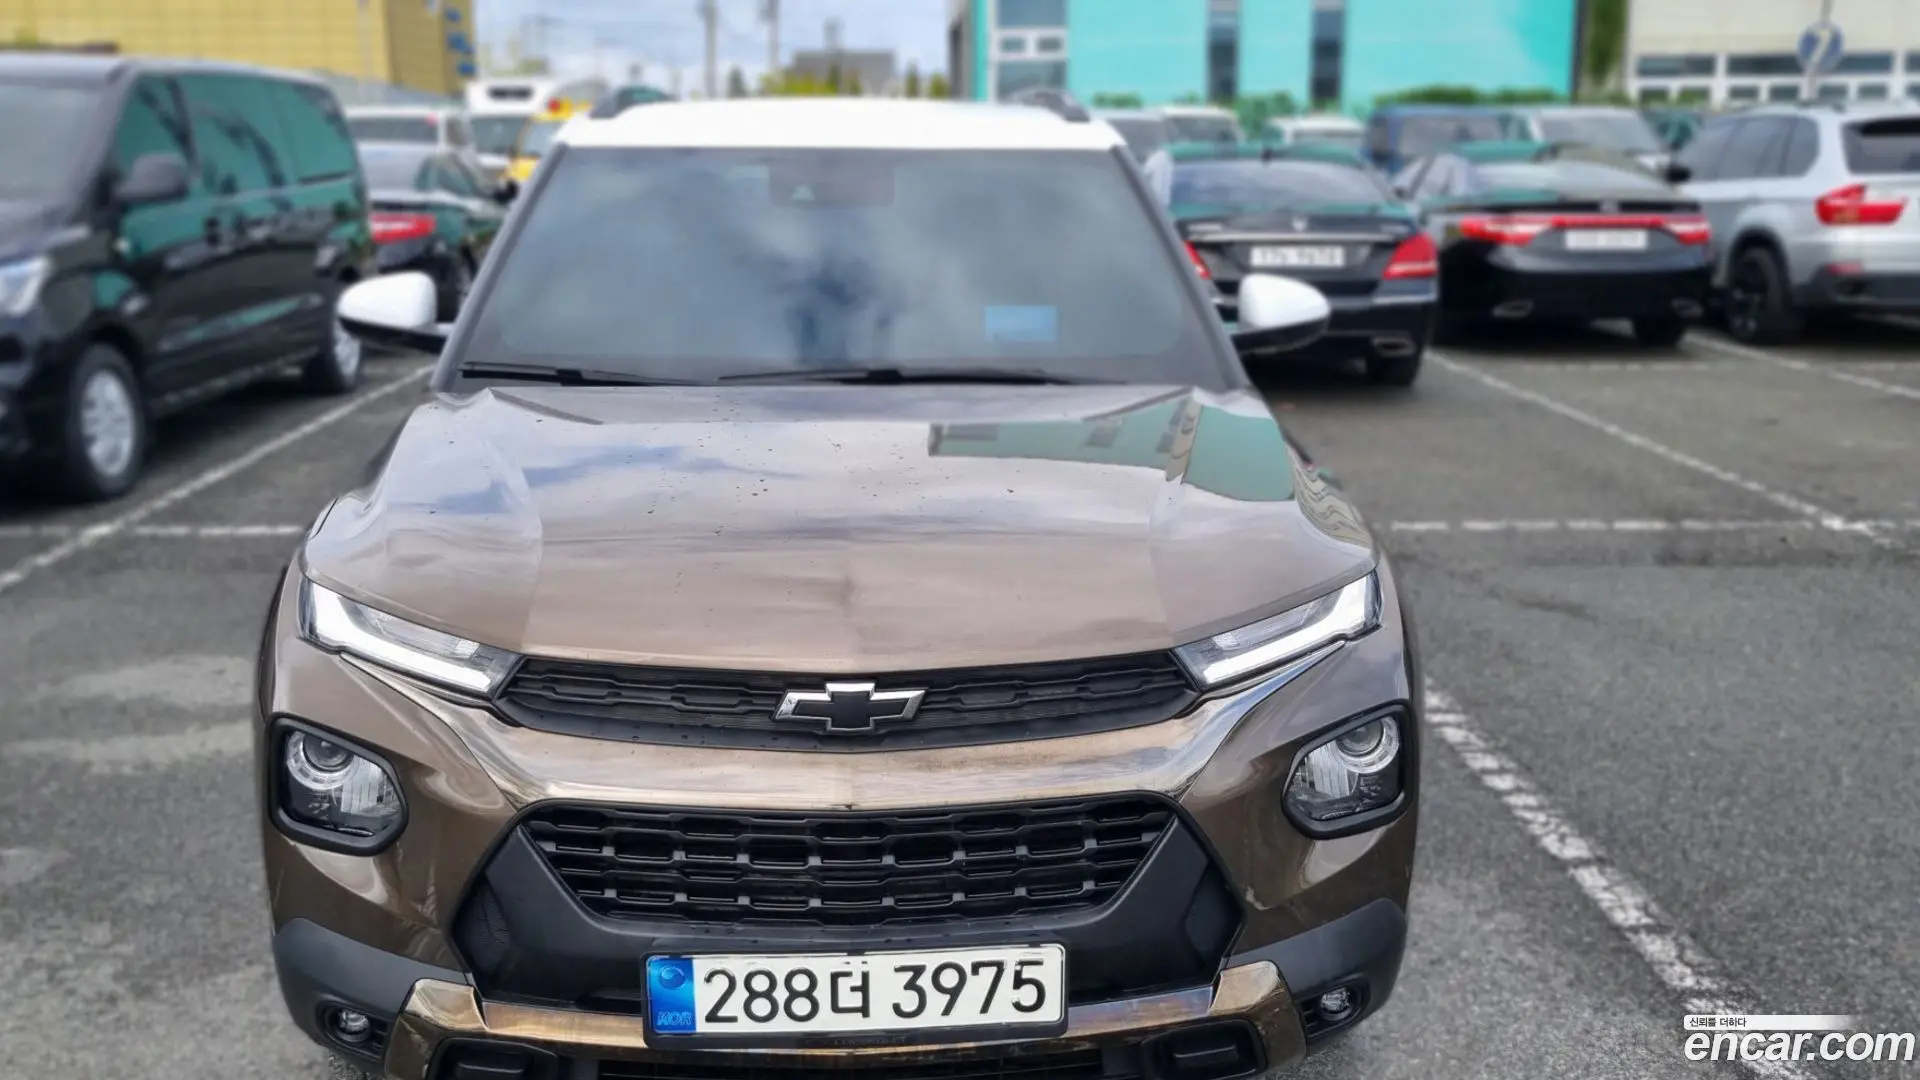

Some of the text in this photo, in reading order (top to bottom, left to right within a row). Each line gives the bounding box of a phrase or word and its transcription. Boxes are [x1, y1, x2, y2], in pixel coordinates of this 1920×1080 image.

[703, 958, 1046, 1023] 288더 3975
[656, 1011, 692, 1026] KOR
